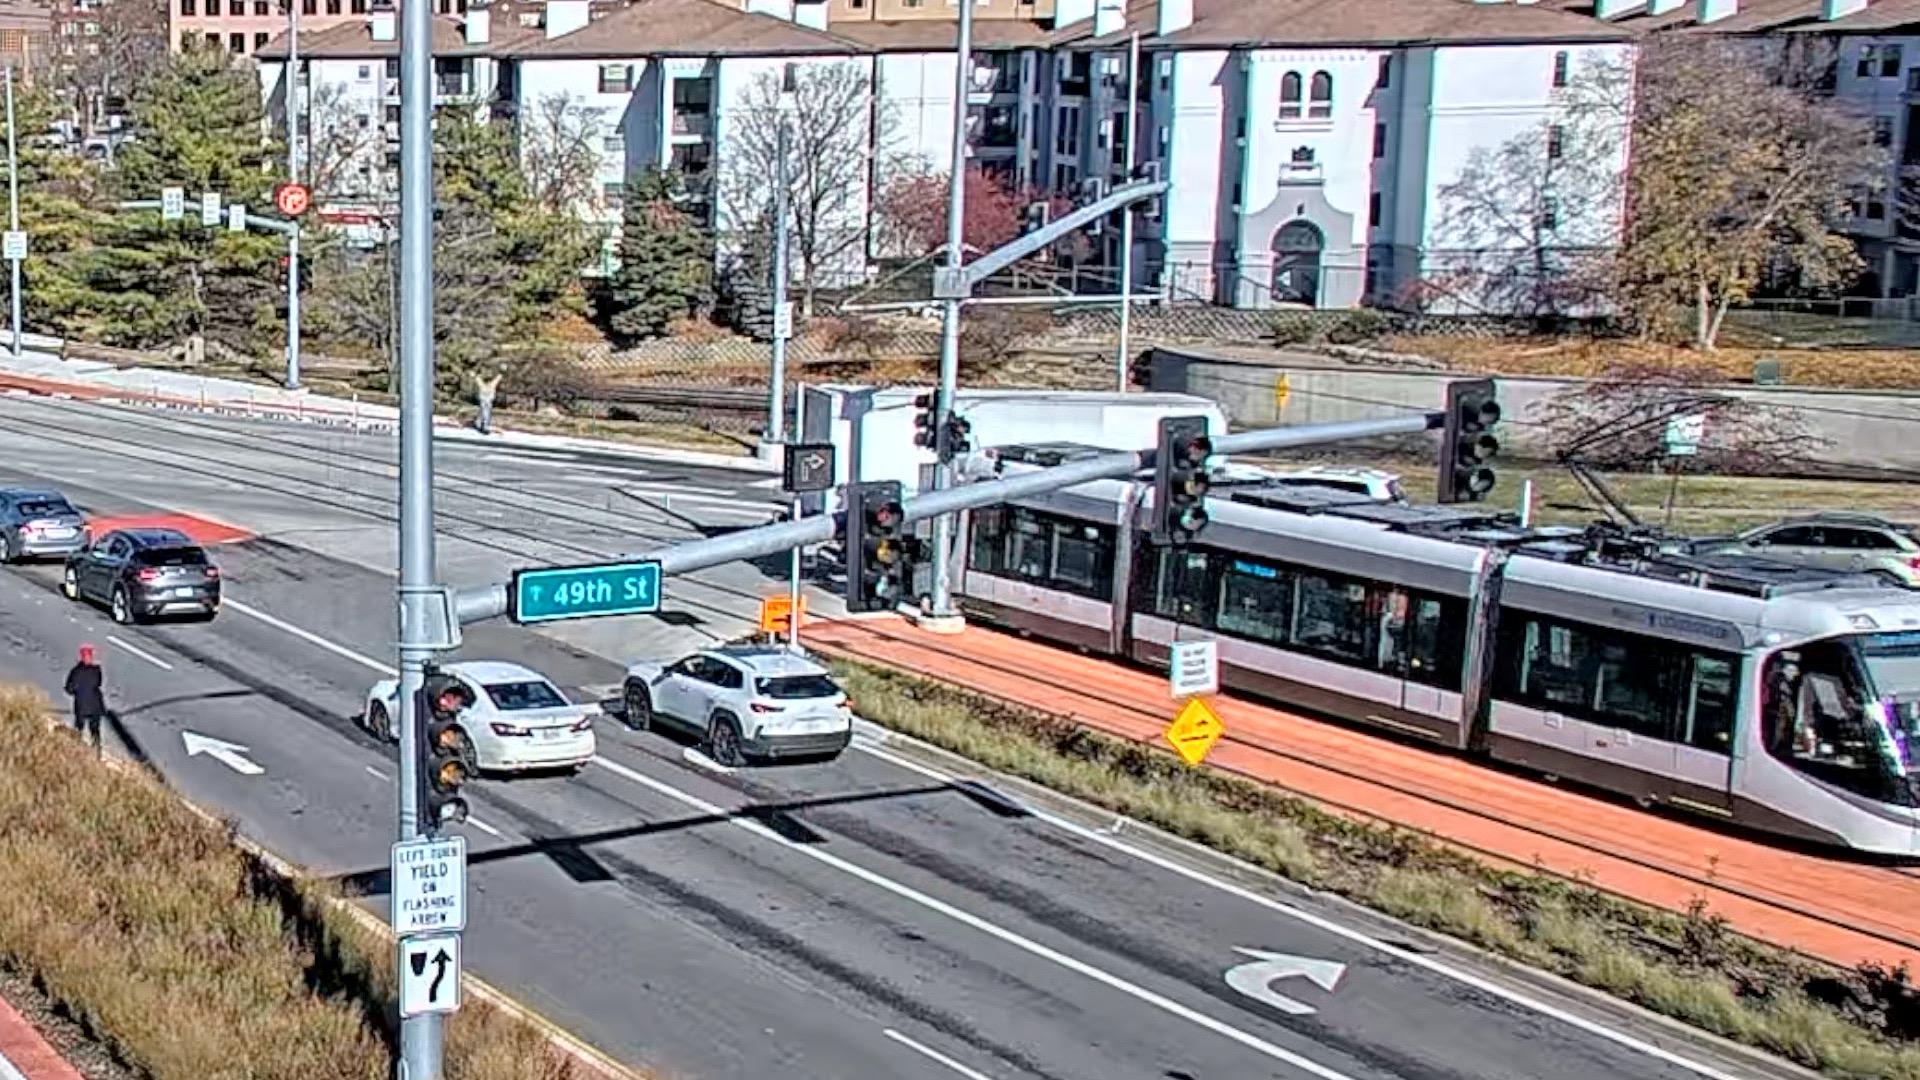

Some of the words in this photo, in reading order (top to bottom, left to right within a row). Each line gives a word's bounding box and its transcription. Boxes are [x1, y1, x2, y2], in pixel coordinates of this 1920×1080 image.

[554, 578, 612, 605] 49th
[623, 576, 647, 600] St
[399, 850, 424, 863] LEFT
[432, 847, 457, 858] TURN
[411, 863, 447, 880] YIELD
[422, 882, 436, 893] ON
[403, 895, 455, 910] FLASHING
[412, 911, 447, 925] ARROW
